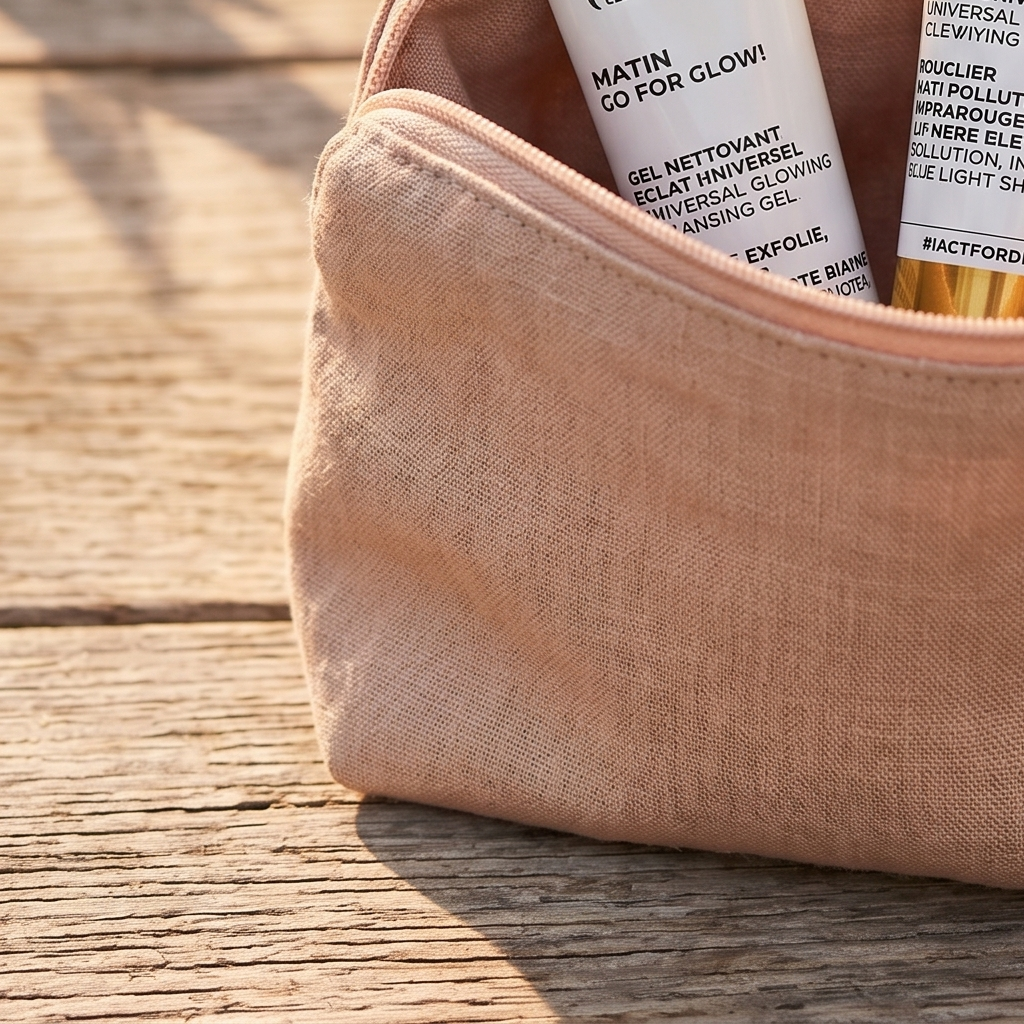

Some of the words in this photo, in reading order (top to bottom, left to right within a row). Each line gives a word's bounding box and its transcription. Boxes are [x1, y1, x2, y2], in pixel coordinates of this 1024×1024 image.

[928, 1, 1019, 25] UNIVERSAL
[592, 48, 671, 90] MATIN
[601, 91, 629, 112] GO
[635, 73, 684, 102] FOR
[690, 44, 766, 82] GLOW!
[920, 58, 996, 82] ROUCLIER
[911, 142, 1002, 170] SOLLUTION,
[628, 166, 662, 186] GEL
[751, 154, 831, 191] GLOWING
[939, 167, 995, 188] LIGHT
[634, 176, 690, 206] ECLAT
[672, 202, 754, 234] ANSING
[745, 227, 828, 264] EXFOLIE,
[791, 270, 822, 286] TE
